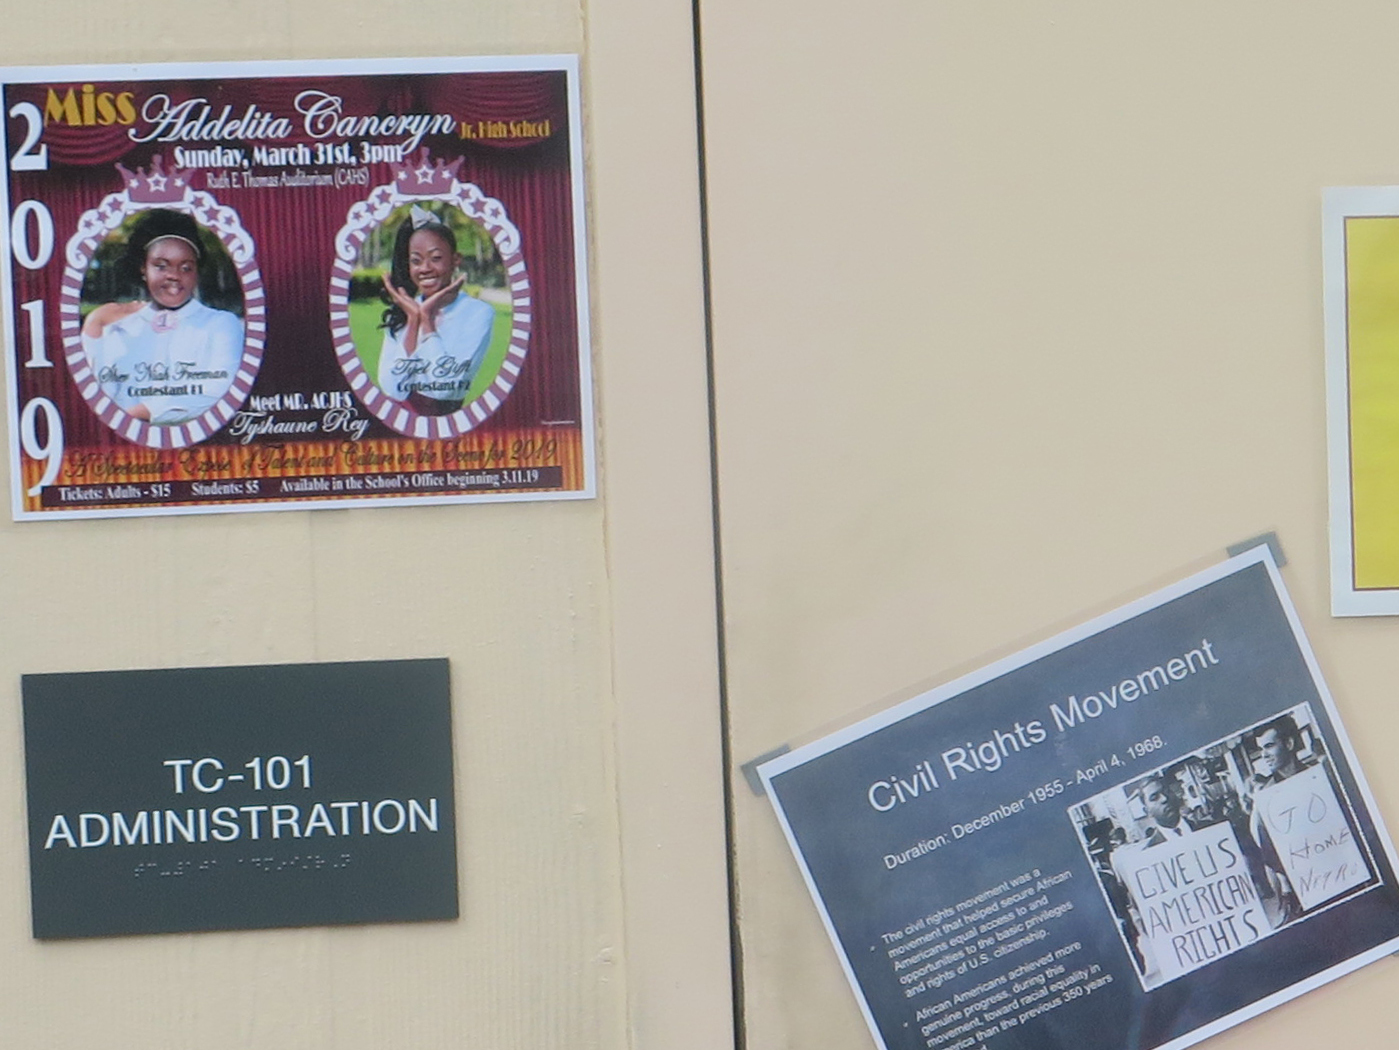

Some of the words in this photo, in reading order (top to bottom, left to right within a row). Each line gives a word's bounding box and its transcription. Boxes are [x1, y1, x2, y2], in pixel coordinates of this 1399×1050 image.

[44, 84, 137, 128] Miss
[128, 94, 293, 142] Addelita
[294, 90, 456, 155] Cancryn
[509, 119, 550, 138] School
[174, 145, 249, 169] Sunday,
[251, 143, 311, 167] March
[314, 142, 357, 166] 31st,
[360, 141, 403, 163] 3pm
[280, 168, 333, 186] Auditorium
[334, 166, 370, 188] (CAHS)
[250, 393, 281, 411] Meet
[322, 407, 369, 441] Rey
[58, 486, 103, 501] Tickets:
[105, 484, 142, 499] Adults
[150, 483, 172, 497] $15
[191, 481, 243, 496] Students:
[245, 480, 260, 494] $5
[280, 477, 330, 494] Available
[332, 476, 345, 491] in
[346, 476, 362, 490] the
[364, 473, 409, 488] School's
[411, 471, 444, 487] Office
[447, 470, 500, 488] beginning
[502, 470, 539, 484] 3.11.19
[867, 759, 940, 812] Civil
[941, 718, 1047, 780] Rights
[1050, 638, 1219, 733] Movement
[163, 755, 313, 794] TC-101
[883, 832, 951, 870] Duration:
[952, 797, 1026, 840] December
[1027, 779, 1065, 807] 1955
[1075, 759, 1109, 787] April
[1127, 735, 1168, 760] 1968.
[44, 798, 439, 849] ADMINISTRATION
[1194, 837, 1237, 878] US
[881, 933, 903, 944] The
[905, 919, 925, 936] civil
[925, 908, 955, 927] rights
[955, 881, 1010, 912] movement
[1010, 873, 1032, 887] was
[1032, 867, 1041, 878] a
[888, 930, 943, 959] movement
[942, 918, 964, 935] that
[964, 904, 999, 926] helped
[1000, 888, 1035, 909] secure
[1036, 869, 1073, 892] African
[893, 941, 949, 972] Americans
[950, 926, 979, 947] equal
[979, 912, 1016, 934] access
[1016, 903, 1028, 917] to
[1028, 894, 1049, 912] and
[1149, 871, 1256, 938] AMERICAN
[899, 949, 966, 985] opportunities
[965, 941, 978, 955] to
[977, 935, 996, 950] the
[996, 922, 1024, 942] basic
[1024, 900, 1074, 931] privileges
[905, 982, 926, 998] and
[926, 969, 956, 988] rights
[957, 961, 969, 975] of
[969, 953, 993, 969] U.S.
[993, 929, 1050, 958] citizenship.
[915, 1000, 952, 1022] African
[953, 976, 1008, 1005] Americans
[1008, 954, 1054, 980] achieved
[1054, 941, 1082, 958] more
[921, 1013, 963, 1036] genuine
[1012, 974, 1046, 995] during
[1045, 963, 1066, 979] this
[976, 1024, 1000, 1042] than
[1000, 1016, 1019, 1031] the
[1019, 996, 1062, 1024] previous
[1062, 986, 1083, 1003] 350
[1083, 974, 1113, 995] years
[984, 1000, 1020, 1022] toward
[1019, 986, 1049, 1006] racial
[1049, 969, 1089, 995] equality
[1089, 963, 1101, 976] in
